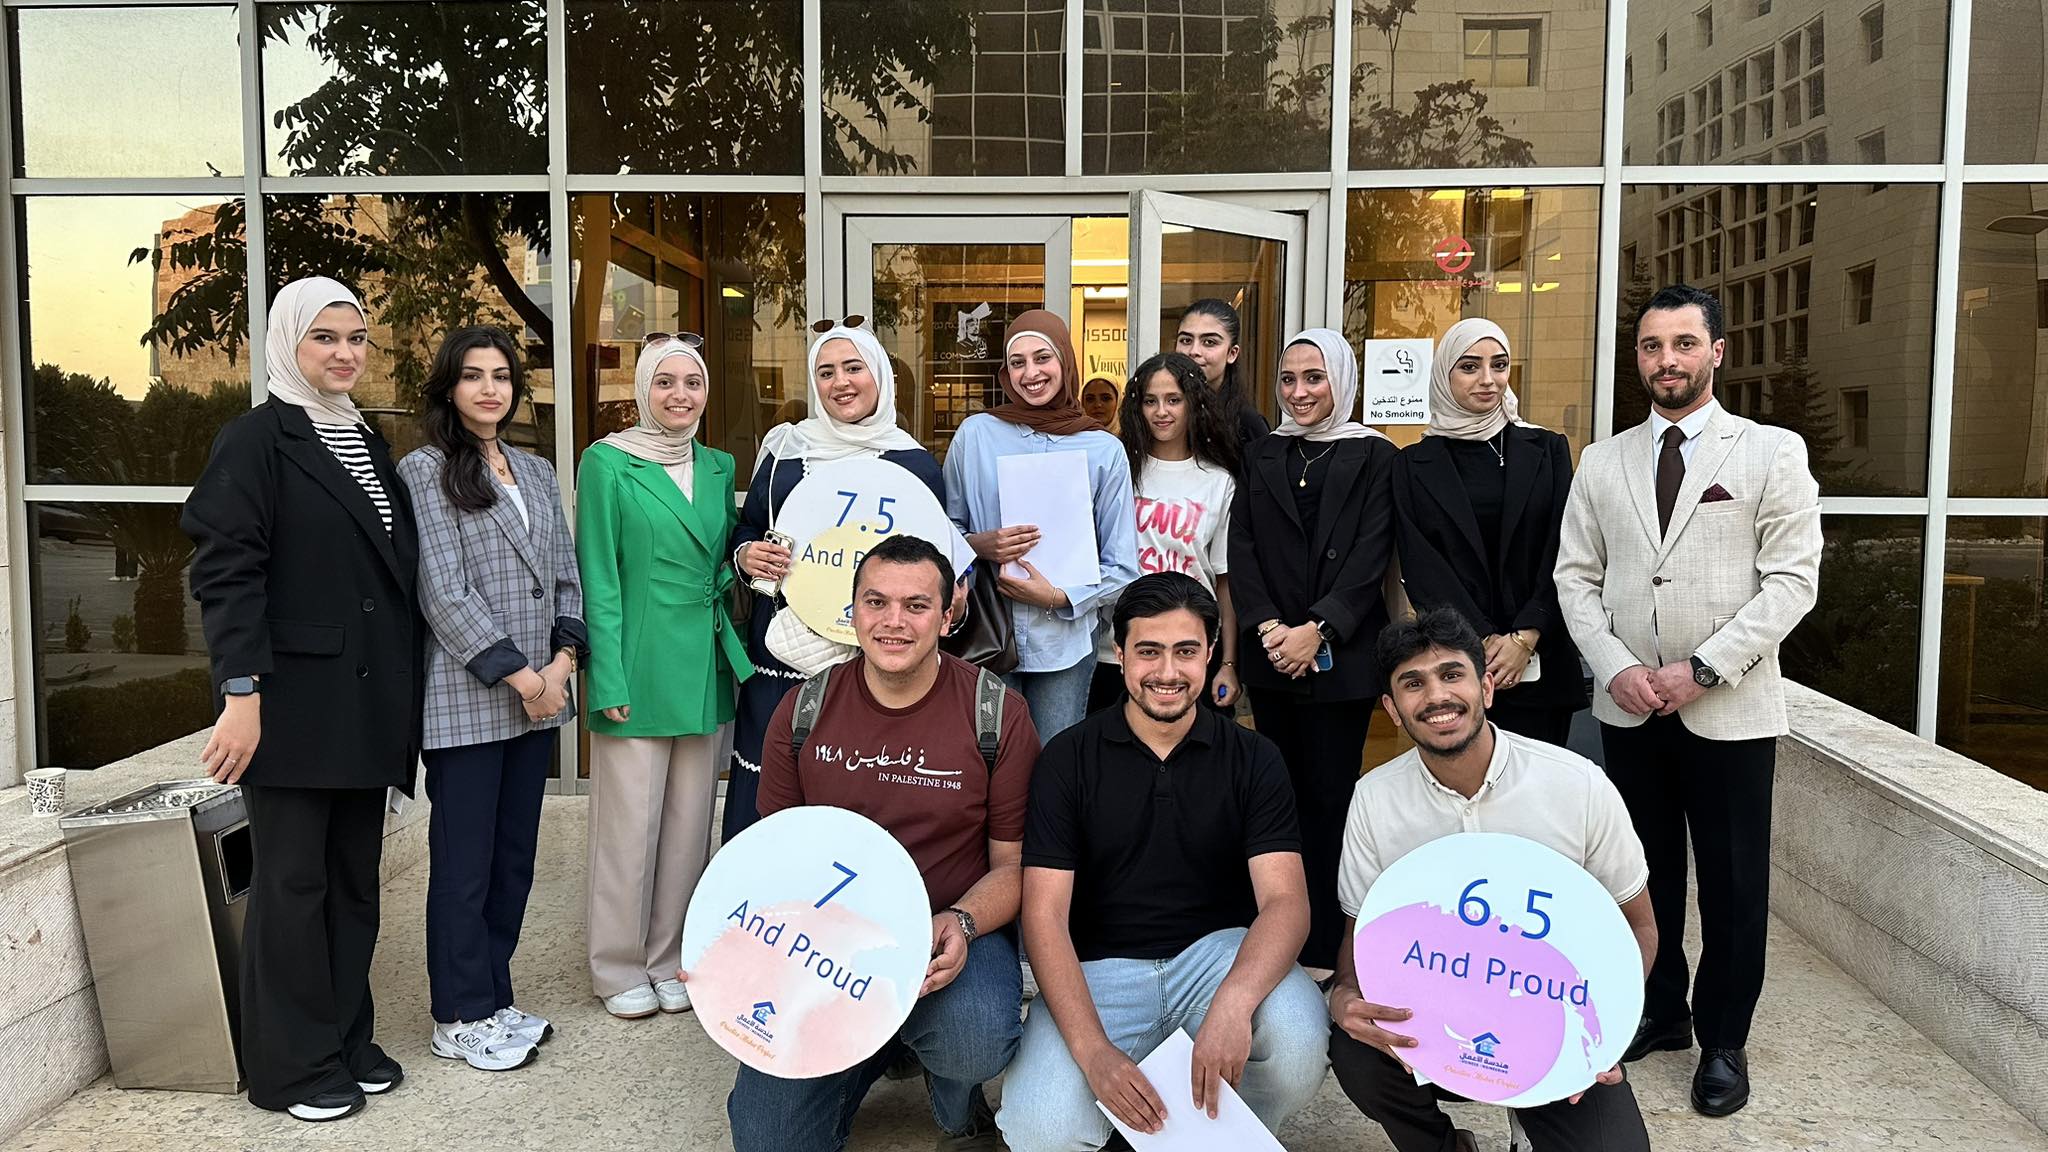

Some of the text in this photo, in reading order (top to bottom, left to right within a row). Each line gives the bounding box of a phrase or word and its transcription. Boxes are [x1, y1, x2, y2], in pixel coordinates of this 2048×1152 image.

[1370, 410, 1424, 419] No Smoking
[1372, 395, 1423, 406] ممنوع التدخين
[835, 490, 896, 535] 7.5
[801, 543, 844, 568] And
[815, 744, 963, 776] في فلسطين ١٩٤٨
[878, 772, 962, 790] IN PALESTINE 1948
[813, 861, 858, 909] 7
[1458, 879, 1553, 940] 6.5
[727, 900, 872, 1001] And Proud
[1403, 940, 1589, 1007] And Proud
